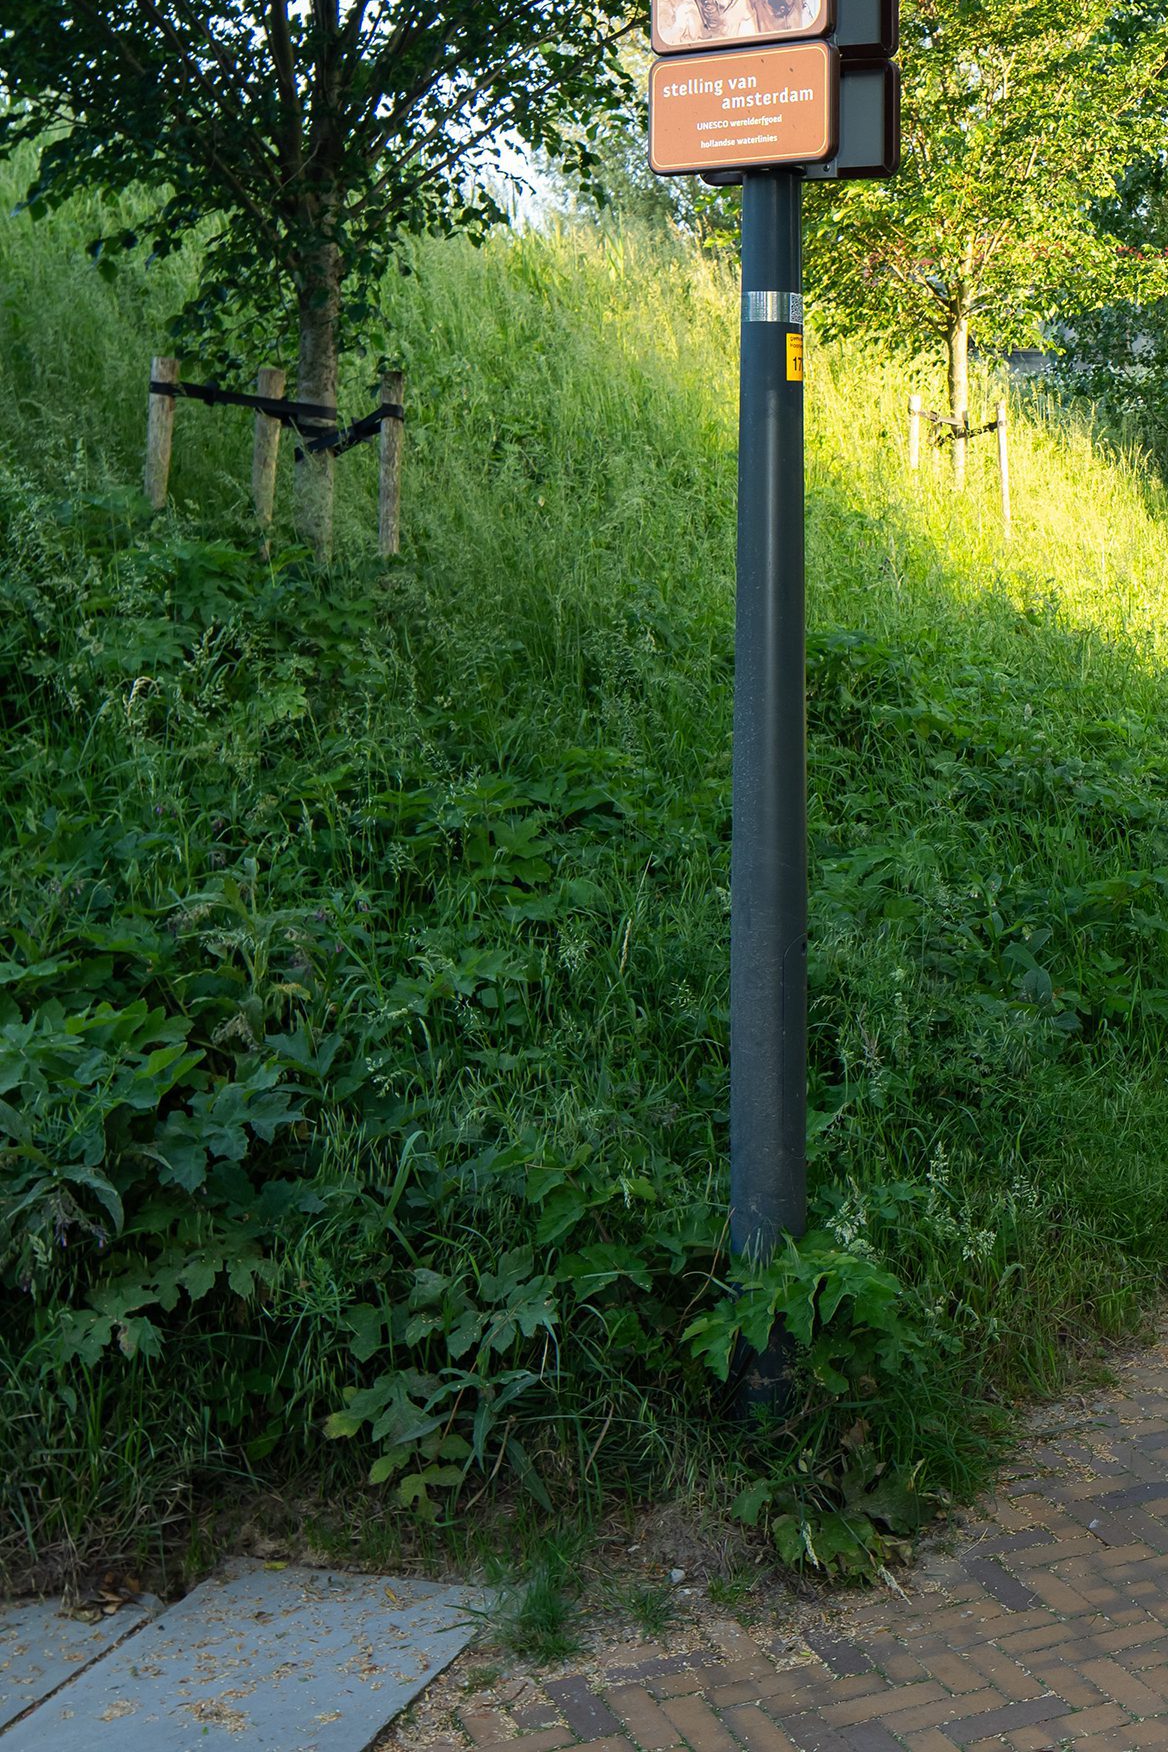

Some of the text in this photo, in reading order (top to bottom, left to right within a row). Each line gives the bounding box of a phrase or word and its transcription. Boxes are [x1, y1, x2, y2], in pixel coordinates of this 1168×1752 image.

[663, 75, 757, 98] stelling van
[721, 87, 813, 110] amsterdam
[697, 114, 782, 130] UNESCO werelderfgoed
[700, 134, 778, 149] hollandse waterlinies
